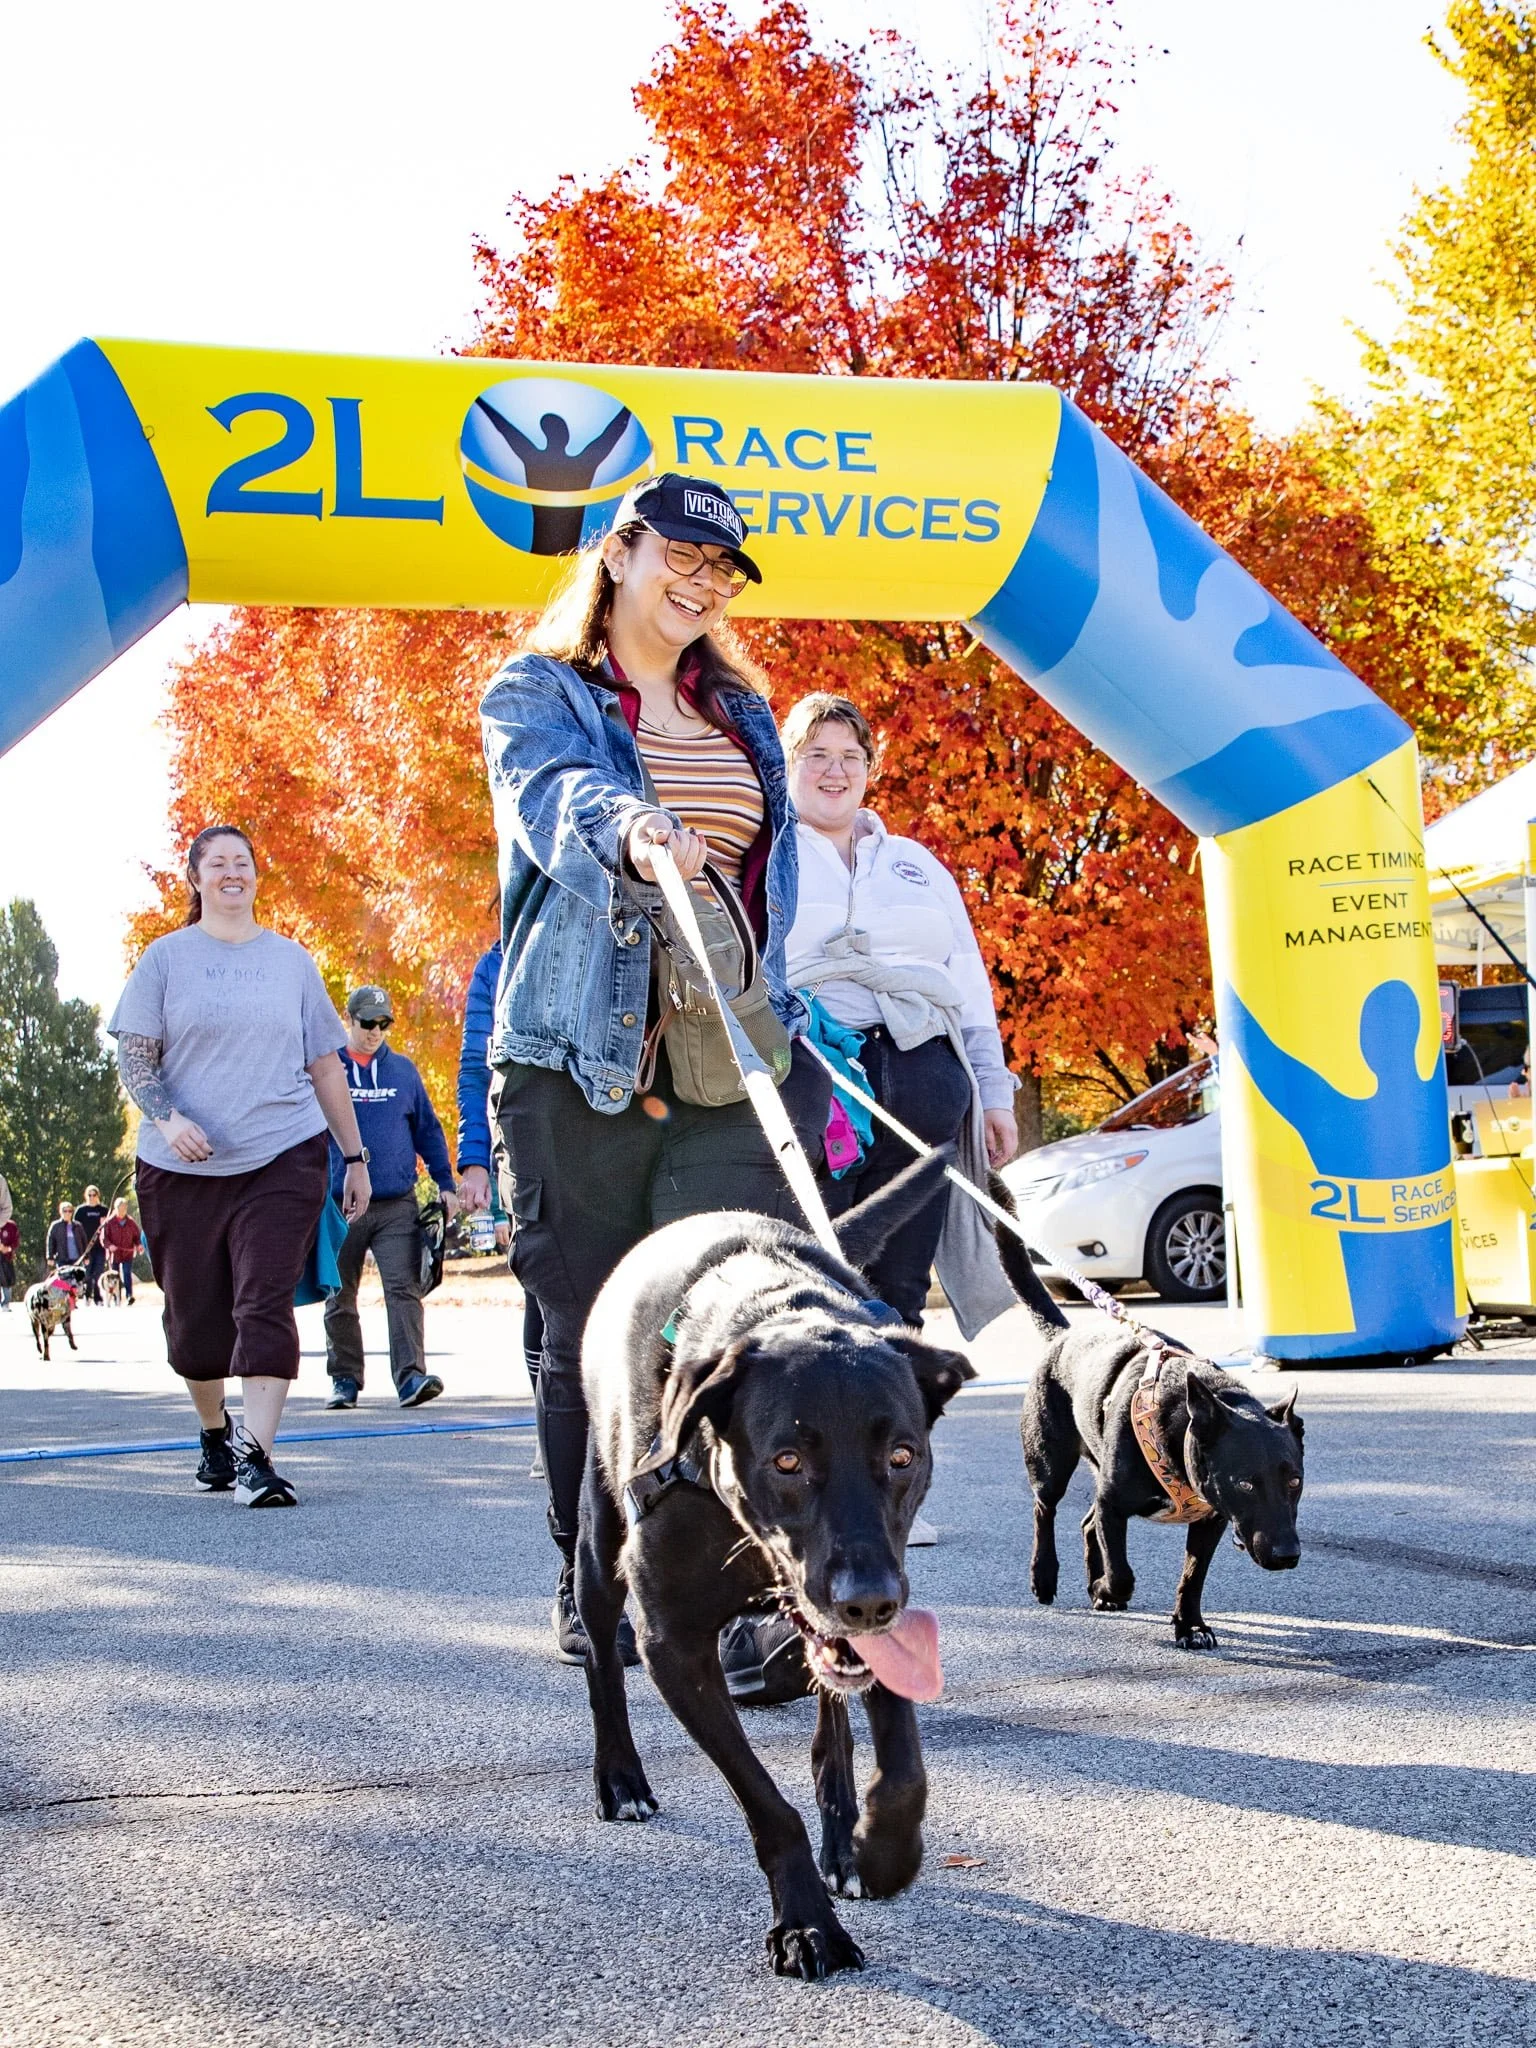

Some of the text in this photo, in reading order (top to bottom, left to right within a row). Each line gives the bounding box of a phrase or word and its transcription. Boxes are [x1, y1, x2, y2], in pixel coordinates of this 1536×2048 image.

[205, 392, 445, 526] 2L
[671, 415, 877, 473] RACE
[726, 489, 1002, 543] ERVICES
[1288, 851, 1425, 876] RACE TIMING
[1332, 892, 1408, 913] EVENT
[206, 967, 226, 980] MY
[1309, 1180, 1386, 1224] 2L
[1391, 1178, 1443, 1202] RACE
